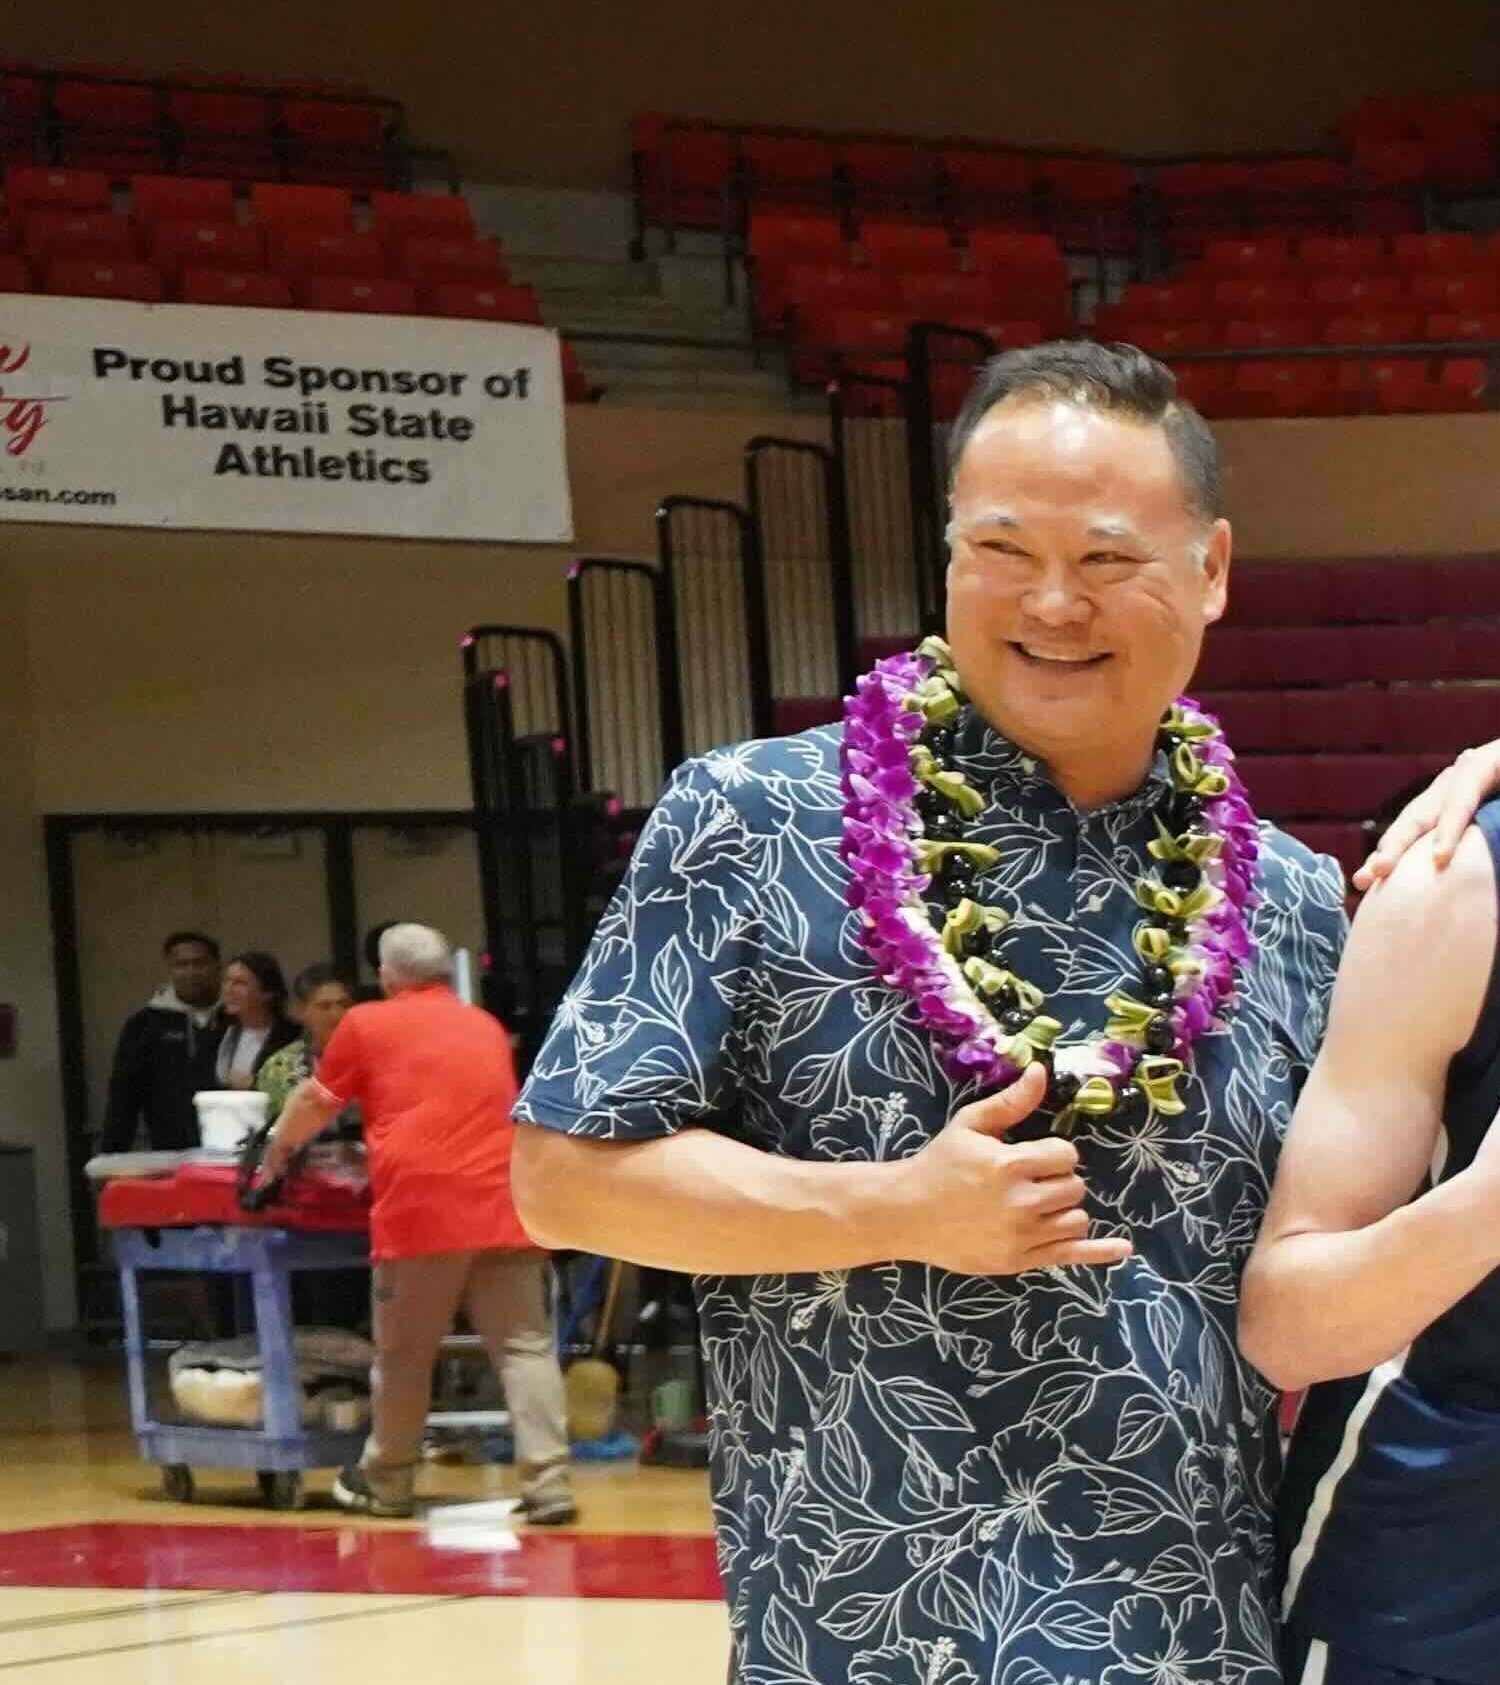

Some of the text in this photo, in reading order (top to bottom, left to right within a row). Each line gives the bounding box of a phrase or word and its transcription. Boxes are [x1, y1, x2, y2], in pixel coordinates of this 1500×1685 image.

[93, 347, 532, 400] Proud Sponsor of
[161, 394, 475, 441] Hawaii State
[213, 442, 432, 485] Athletics
[0, 487, 117, 505] san.com
